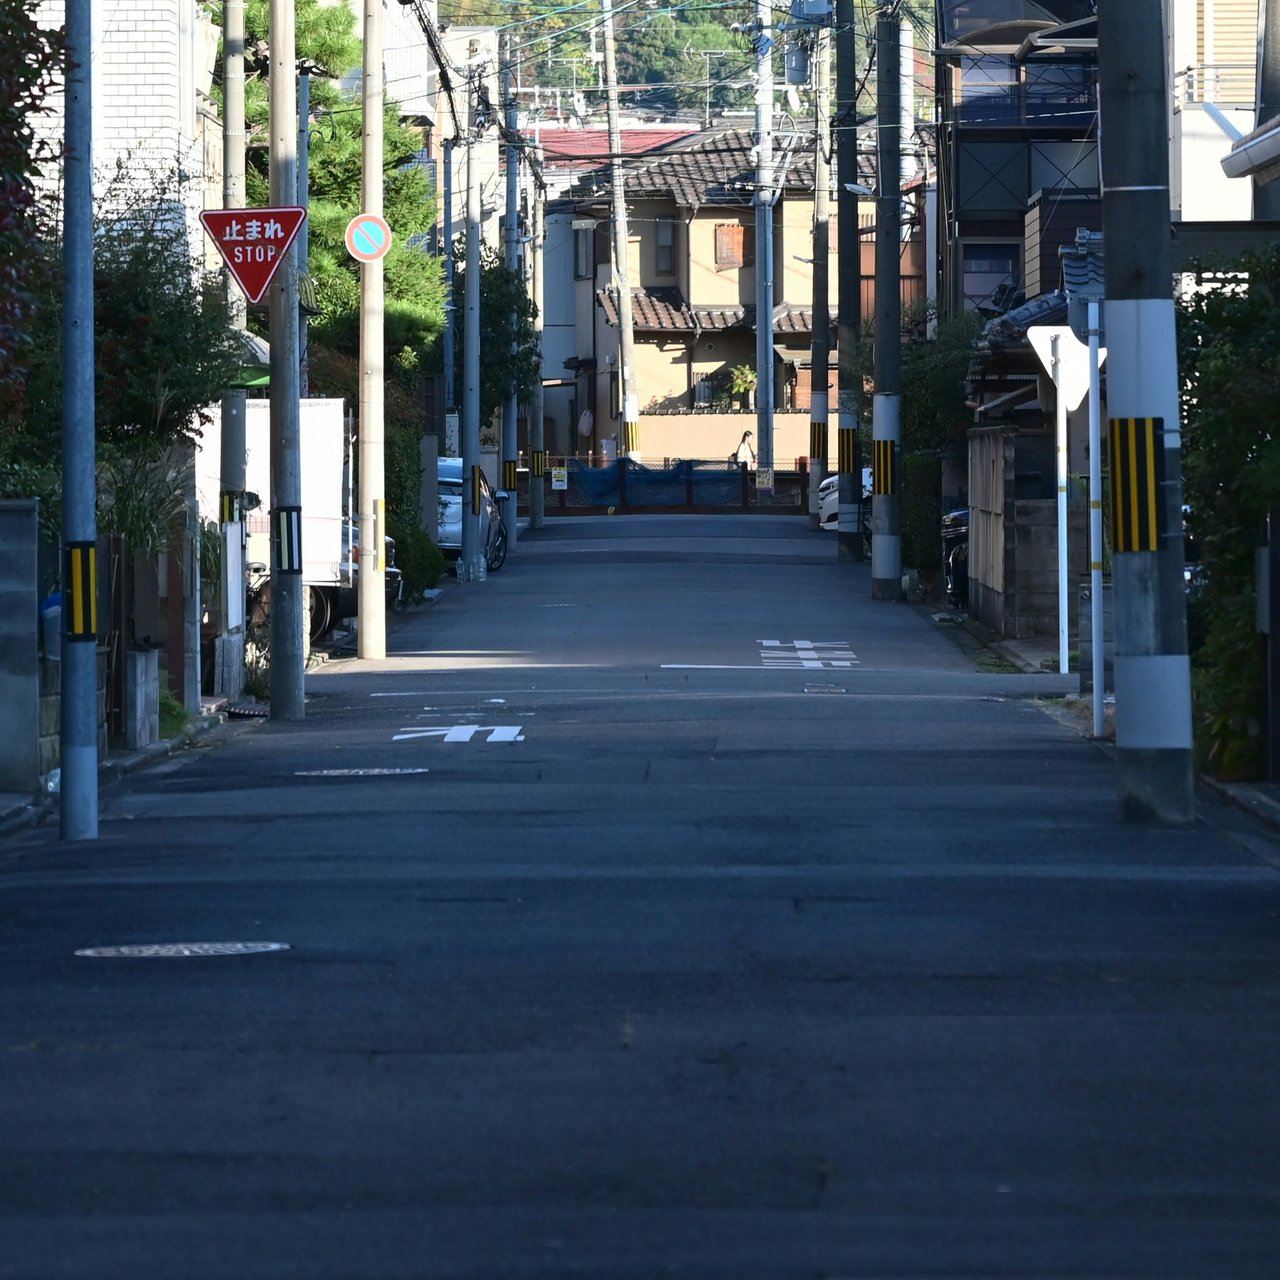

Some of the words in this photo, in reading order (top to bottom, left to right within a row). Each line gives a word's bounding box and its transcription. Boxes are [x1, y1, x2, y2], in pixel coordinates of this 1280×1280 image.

[223, 219, 284, 240] 止まれ
[234, 245, 276, 263] STOP
